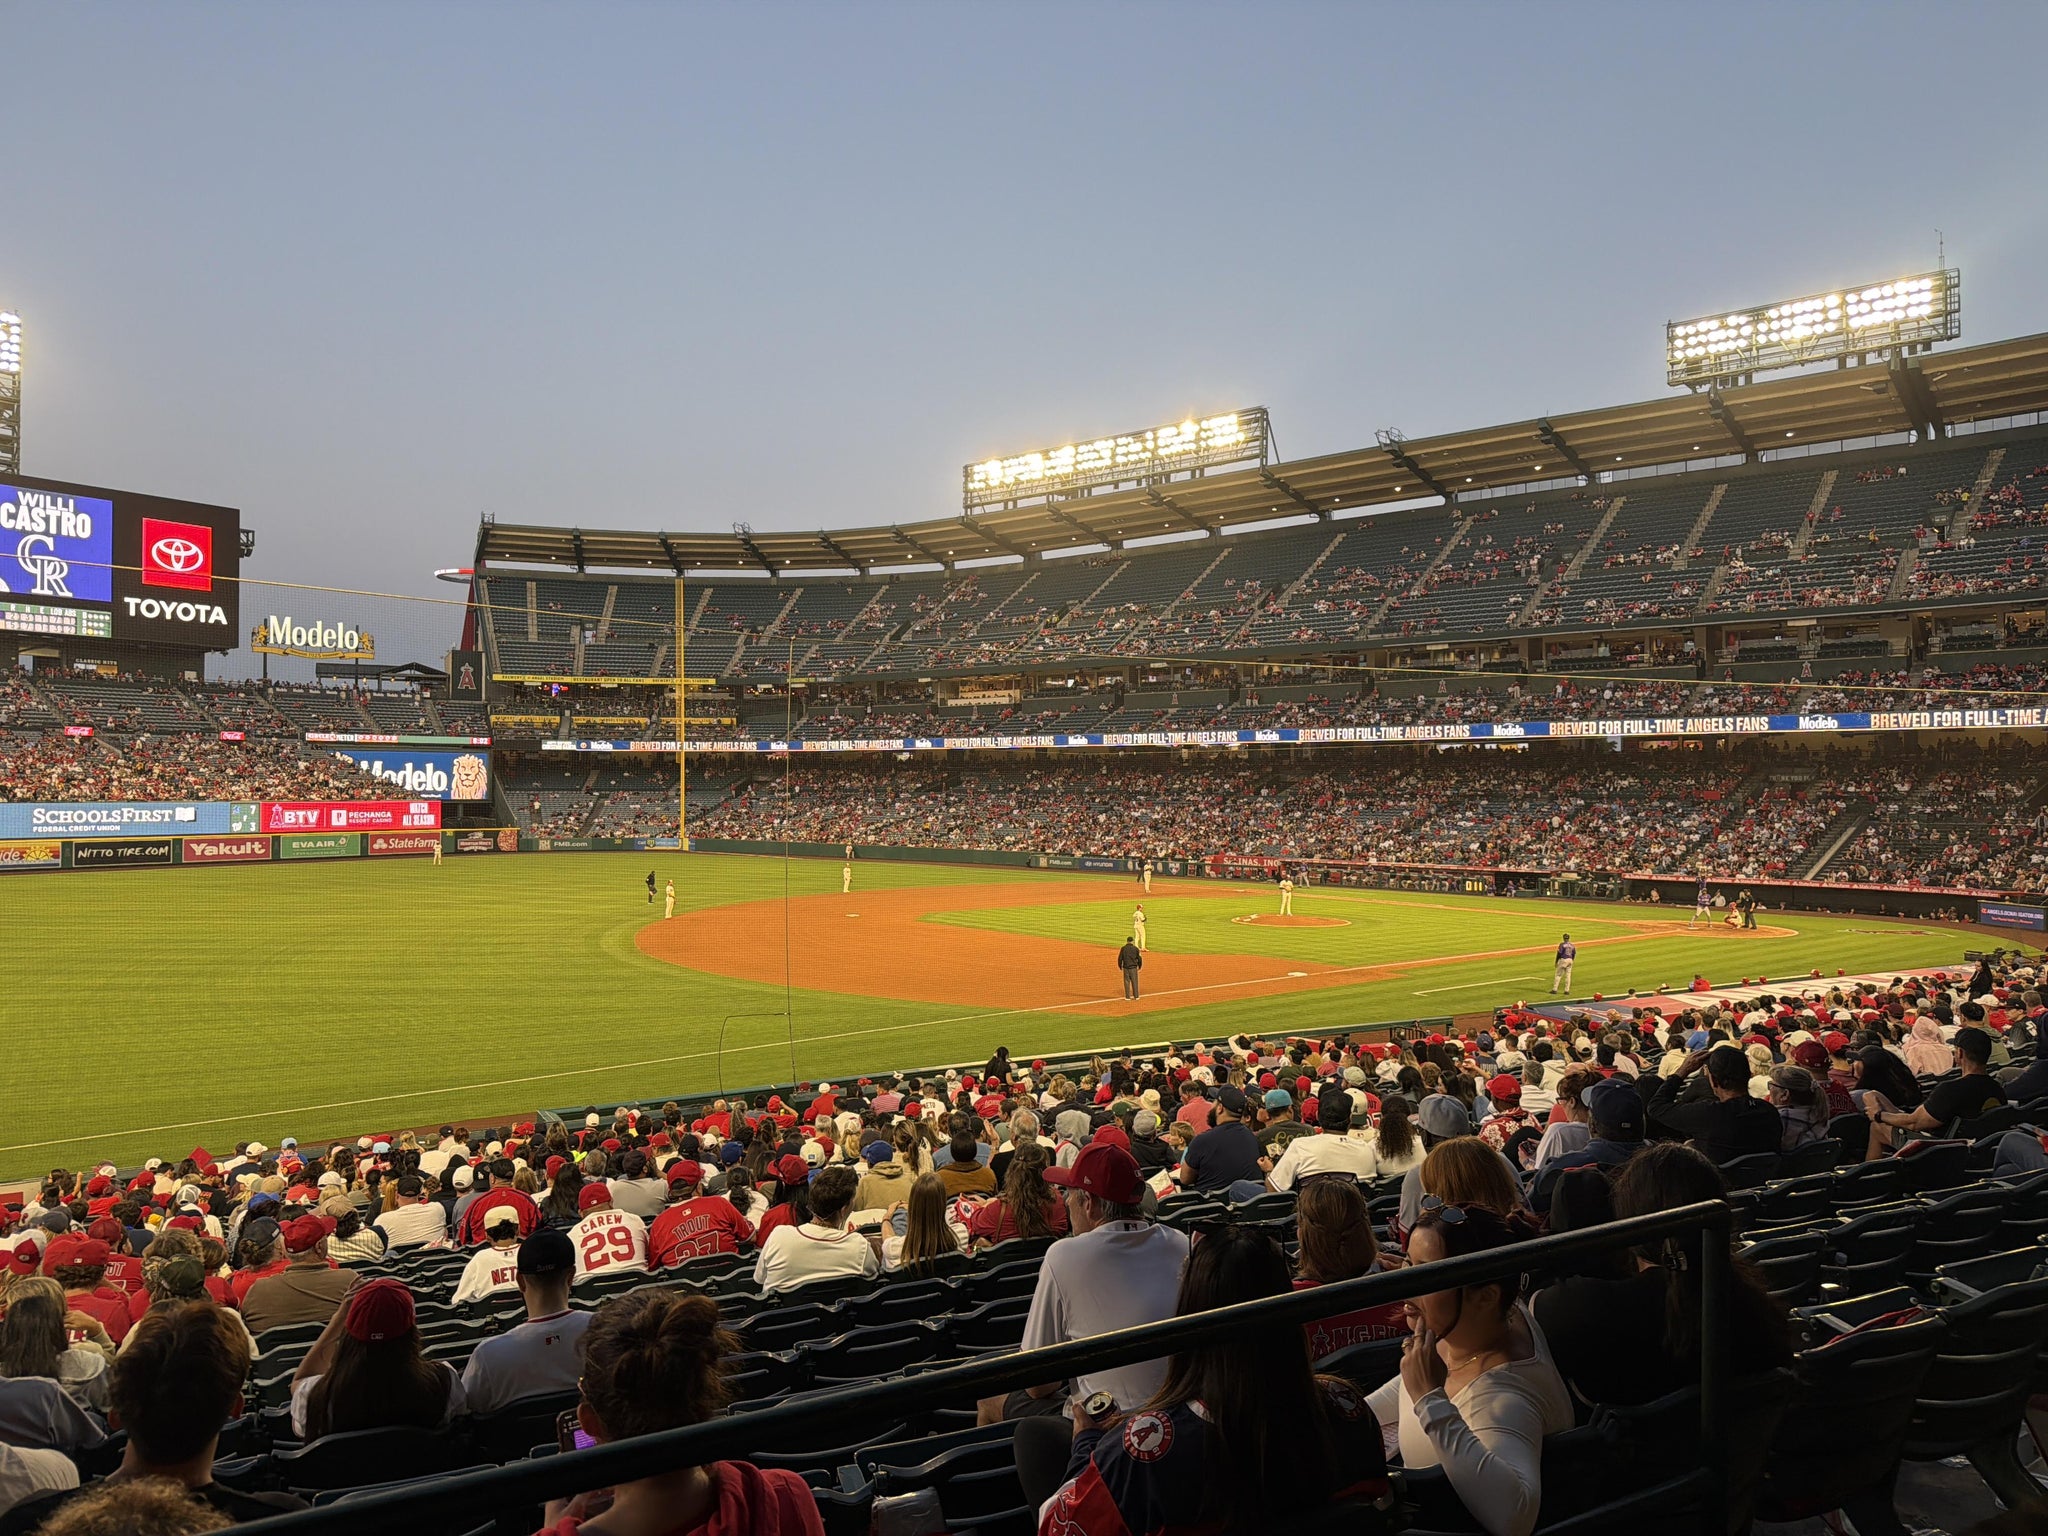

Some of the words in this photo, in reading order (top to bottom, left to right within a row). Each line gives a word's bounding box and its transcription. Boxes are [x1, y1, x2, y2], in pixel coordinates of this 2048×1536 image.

[18, 491, 74, 513] WILLI
[0, 503, 92, 539] CASTRO
[123, 597, 228, 625] TOYOTA
[268, 615, 359, 649] Modelo
[1549, 722, 1597, 735] BREWED
[1599, 721, 1622, 734] FOR
[1623, 719, 1684, 734] FULL-TIME
[1686, 717, 1734, 732] ANGELS
[1736, 716, 1769, 731] FANS
[1799, 716, 1838, 730] Modelo
[1870, 713, 1930, 728] BREWED
[1933, 712, 1962, 727] FOR
[1965, 710, 2041, 726] FULL-TIME
[1103, 734, 1133, 745] BREWED
[1133, 733, 1148, 744] FOR
[1148, 732, 1186, 744] FULL-TIME
[1186, 732, 1216, 743] ANGELS
[1216, 731, 1238, 742] FANS
[1299, 728, 1336, 741] BREWED
[1337, 728, 1355, 740] FOR
[1356, 727, 1403, 739] FULL-TIME
[1404, 725, 1443, 738] ANGELS
[1444, 725, 1470, 738] FANS
[1493, 724, 1524, 736] Modelo
[630, 741, 661, 750] BREWED
[661, 741, 677, 750] FOR
[739, 741, 758, 750] FANS
[944, 738, 968, 748] BREWED
[968, 738, 981, 748] FOR
[981, 738, 1012, 748] FULL-TIME
[1012, 736, 1037, 747] ANGELS
[1037, 736, 1055, 746] FANS
[250, 805, 256, 815] 7
[348, 811, 392, 819] PECHANGA
[250, 822, 256, 831] 3
[77, 847, 113, 859] NITTO
[117, 845, 169, 857] TIRE.COM
[189, 838, 265, 856] Yakult
[292, 841, 317, 849] EVA
[580, 1214, 623, 1234] CAREW
[671, 1214, 710, 1241] TROUT
[580, 1226, 635, 1271] 29
